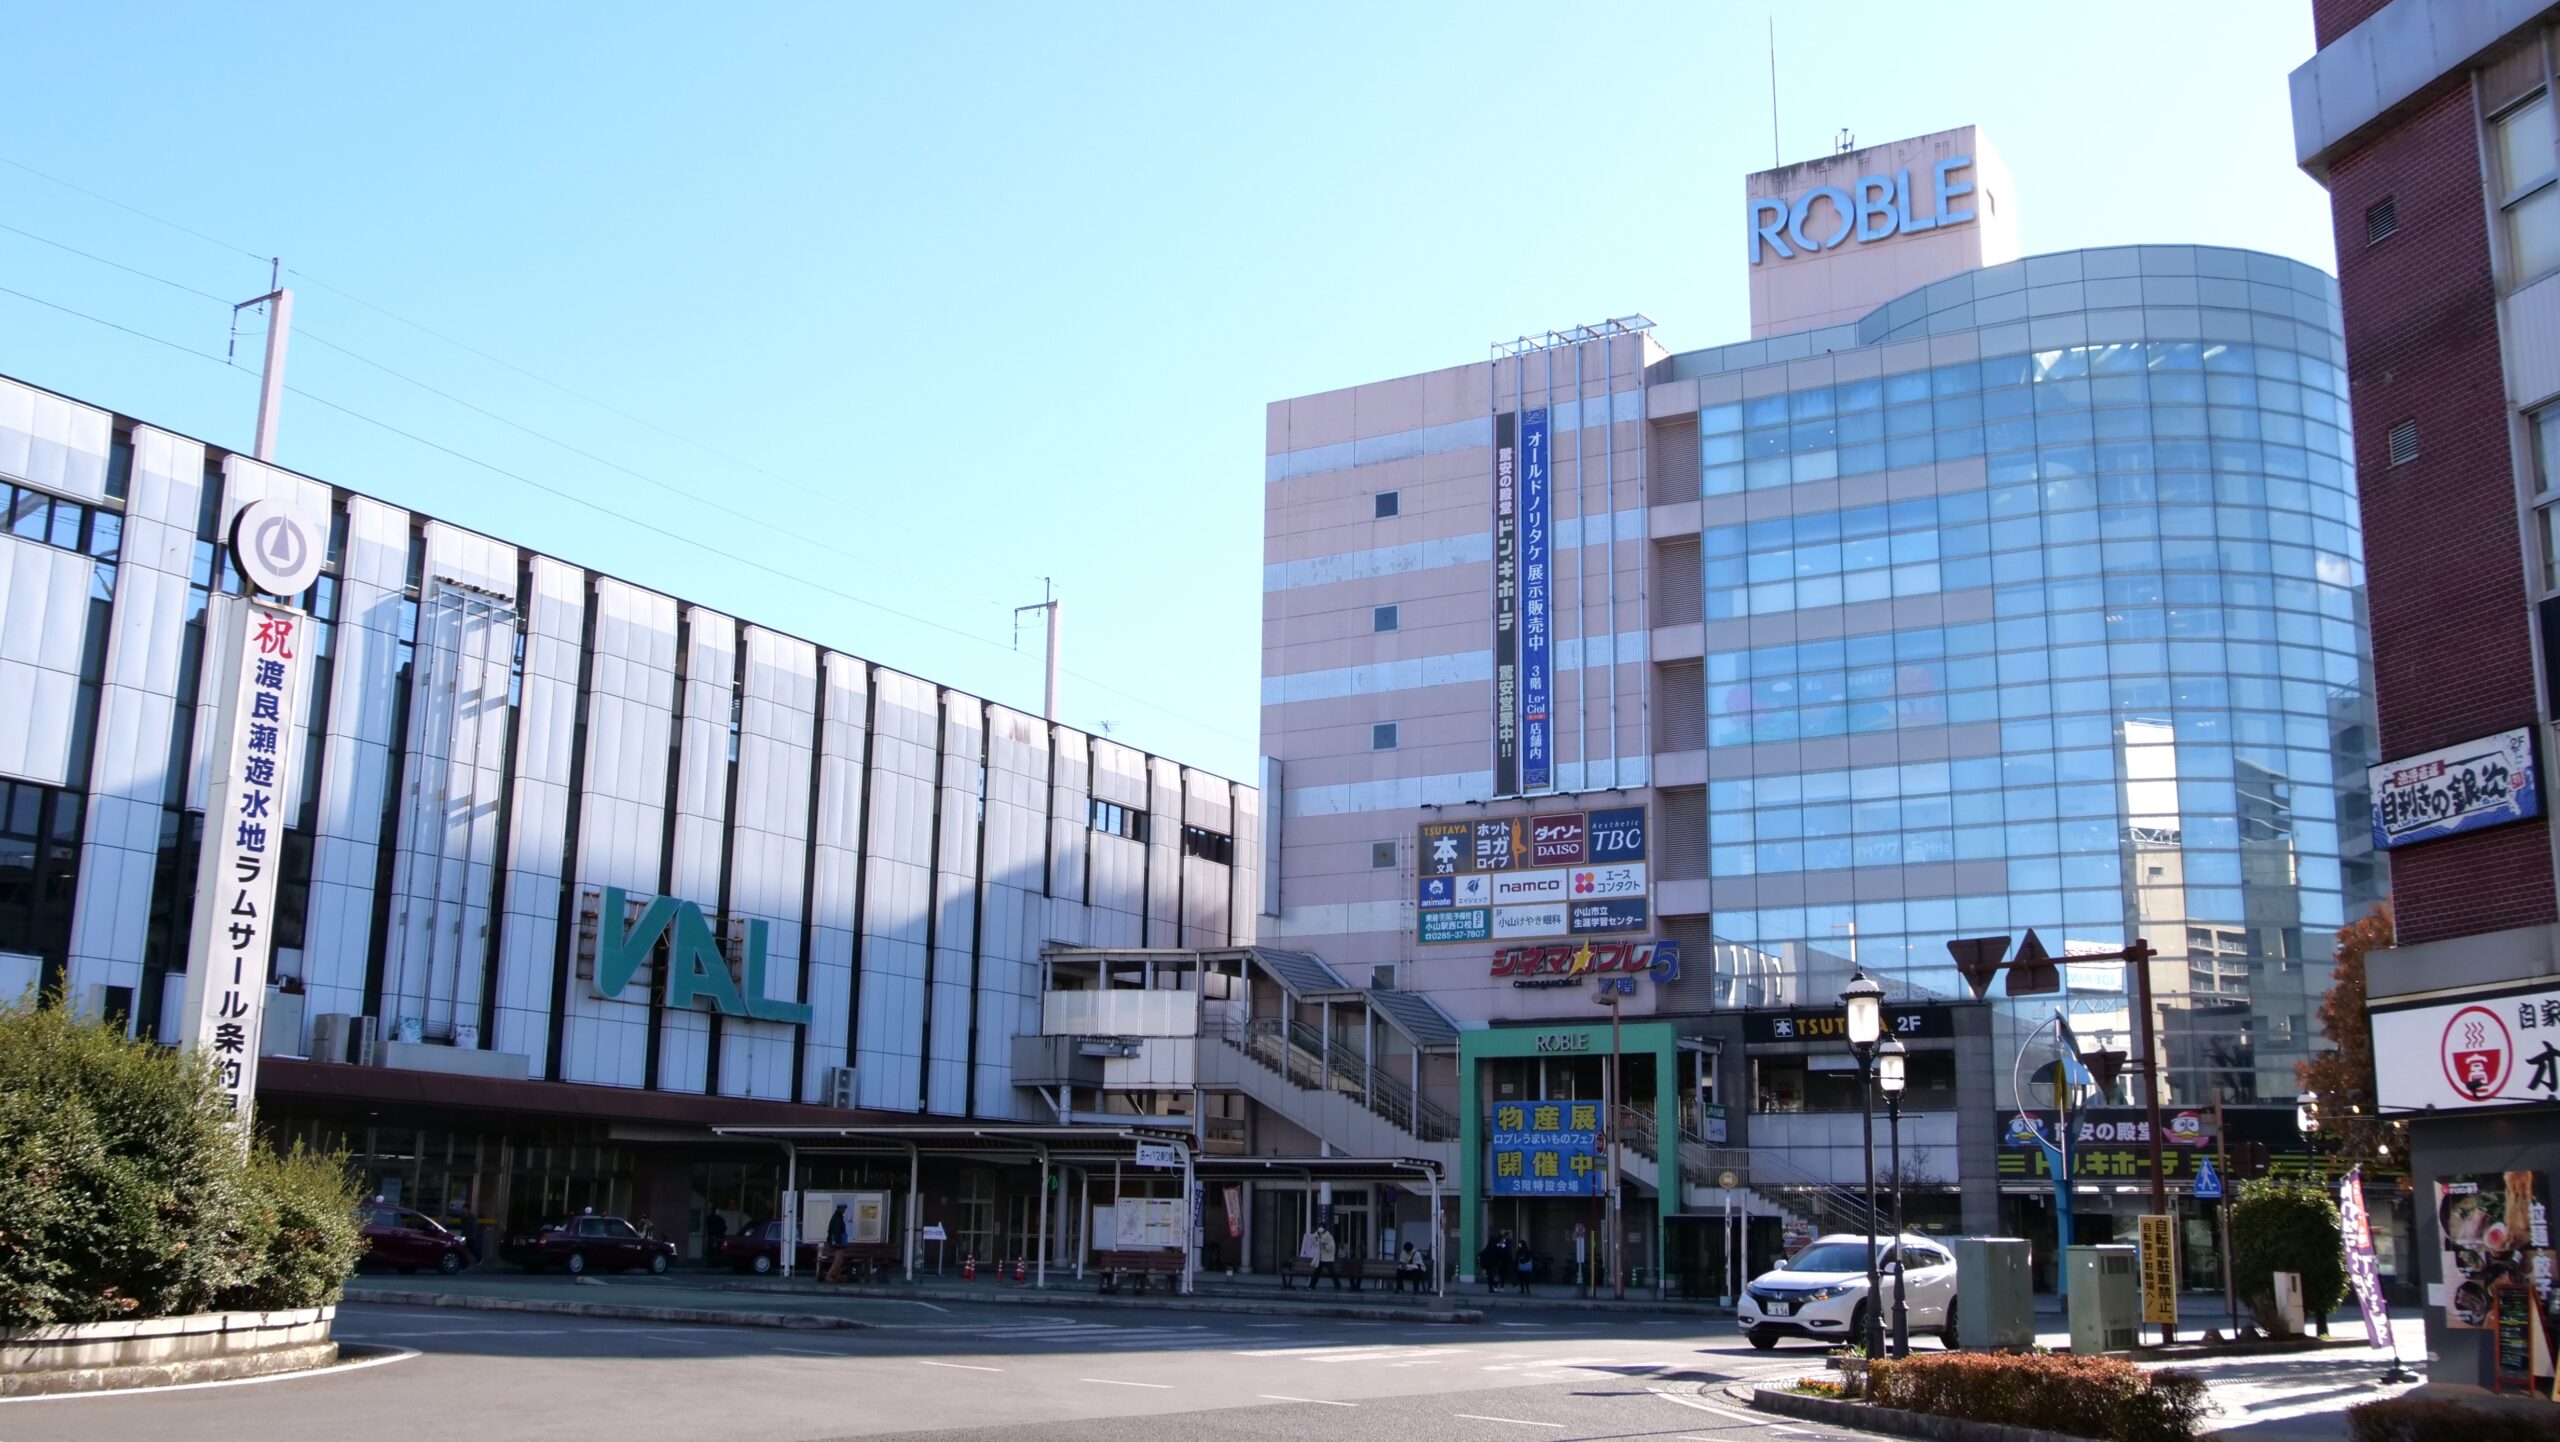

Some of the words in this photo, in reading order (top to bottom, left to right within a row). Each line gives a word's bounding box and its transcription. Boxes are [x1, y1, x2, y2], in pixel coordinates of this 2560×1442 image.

[1750, 155, 1976, 265] ROBLE
[1498, 447, 1513, 514] 驚安の殿堂
[1527, 431, 1544, 561] オールドノリタケ
[1527, 564, 1544, 651] 展示販売中
[253, 611, 293, 660] 祝
[1529, 722, 1542, 760] 店舗内
[2510, 735, 2525, 750] 2F
[2381, 761, 2509, 826] 目利きの銀次
[1423, 825, 1468, 836] TSUTAYA
[1477, 822, 1510, 836] ホット
[1591, 818, 1640, 830] Aesthetic
[1534, 824, 1582, 842] ダイソー
[1592, 828, 1642, 852] TBC
[1433, 836, 1459, 864] 本
[1476, 838, 1510, 855] ヨガ
[1537, 843, 1580, 857] DAISO
[1437, 864, 1454, 874] 文具
[1477, 856, 1510, 869] ロイブ
[1606, 869, 1632, 881] エース
[1500, 879, 1560, 893] namco
[1597, 880, 1641, 893] コンタクト
[1421, 896, 1452, 908] animate
[1495, 908, 1502, 916] 3F
[1574, 906, 1608, 917] 小山市立
[1425, 920, 1473, 932] 小山駅西口校
[1498, 913, 1562, 928] 小山けやき眼科
[1574, 915, 1643, 928] 生涯学習センター
[593, 885, 814, 1024] VAL
[1897, 1015, 1921, 1032] 2F
[1536, 1032, 1590, 1051] ROBLE
[1498, 1104, 1597, 1132] 物産展
[1496, 1151, 1594, 1178] 開催中
[1512, 1179, 1579, 1193] 3階特設会場
[2155, 1219, 2172, 1313] 自転車駐車禁止
